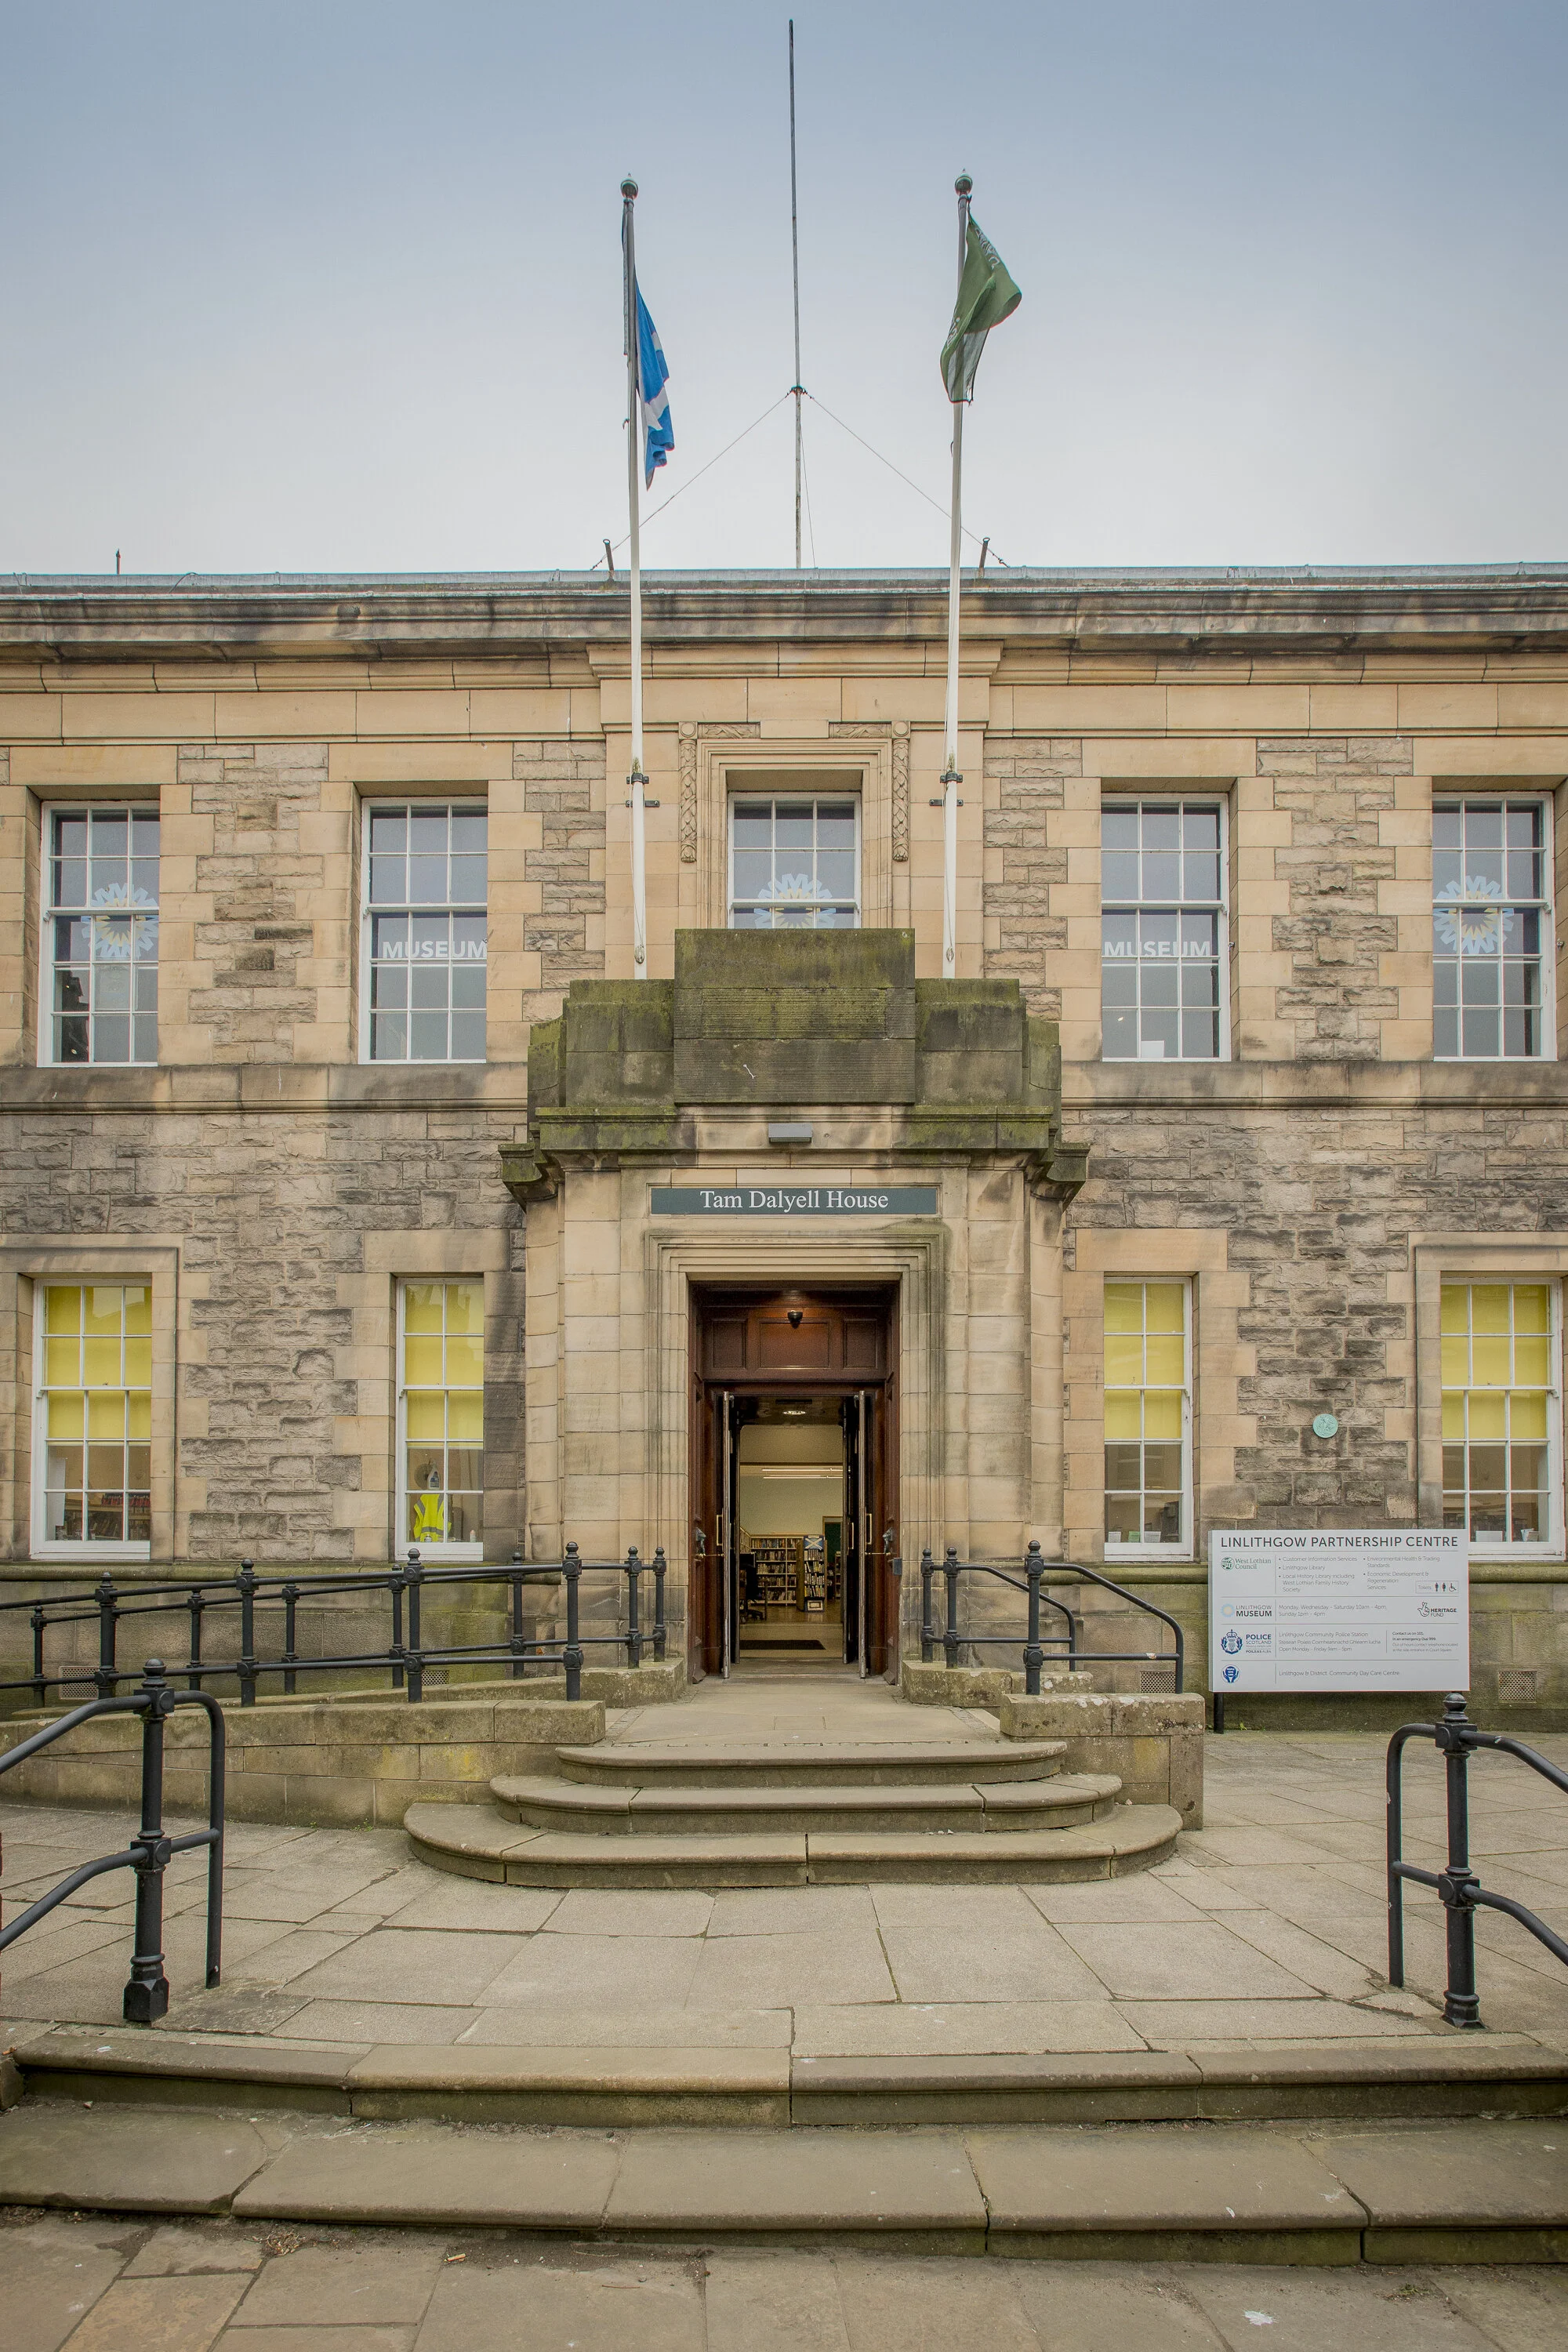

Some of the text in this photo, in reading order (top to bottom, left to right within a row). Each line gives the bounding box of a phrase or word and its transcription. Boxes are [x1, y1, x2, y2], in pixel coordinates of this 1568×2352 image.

[383, 941, 487, 958] MUSEUM
[1104, 941, 1210, 956] MUSEUM
[700, 1191, 888, 1213] Tam Dalyell House
[1221, 1537, 1458, 1548] LINLITHGOW PARTNERSHIP CENTRE
